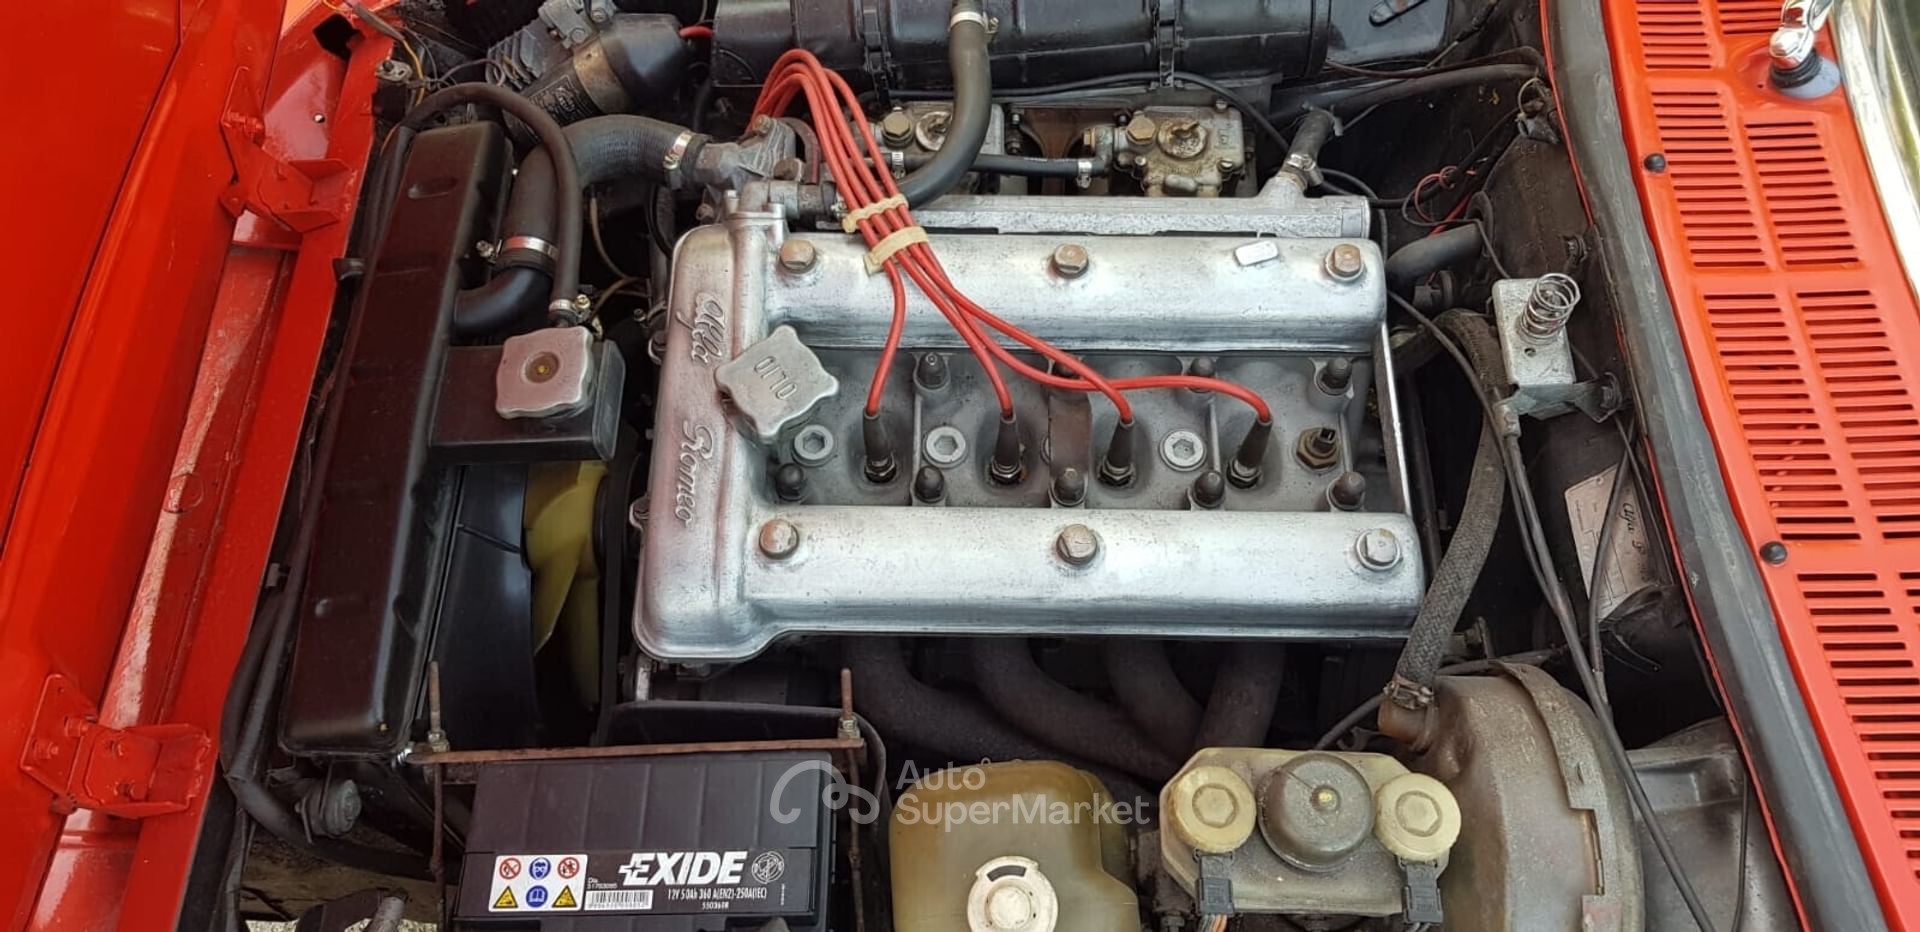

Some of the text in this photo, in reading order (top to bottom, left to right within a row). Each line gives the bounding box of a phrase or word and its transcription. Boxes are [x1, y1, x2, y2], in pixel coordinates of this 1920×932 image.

[674, 291, 726, 526] Alfa Romeo
[618, 851, 748, 886] EXIDE
[667, 887, 680, 901] 12V
